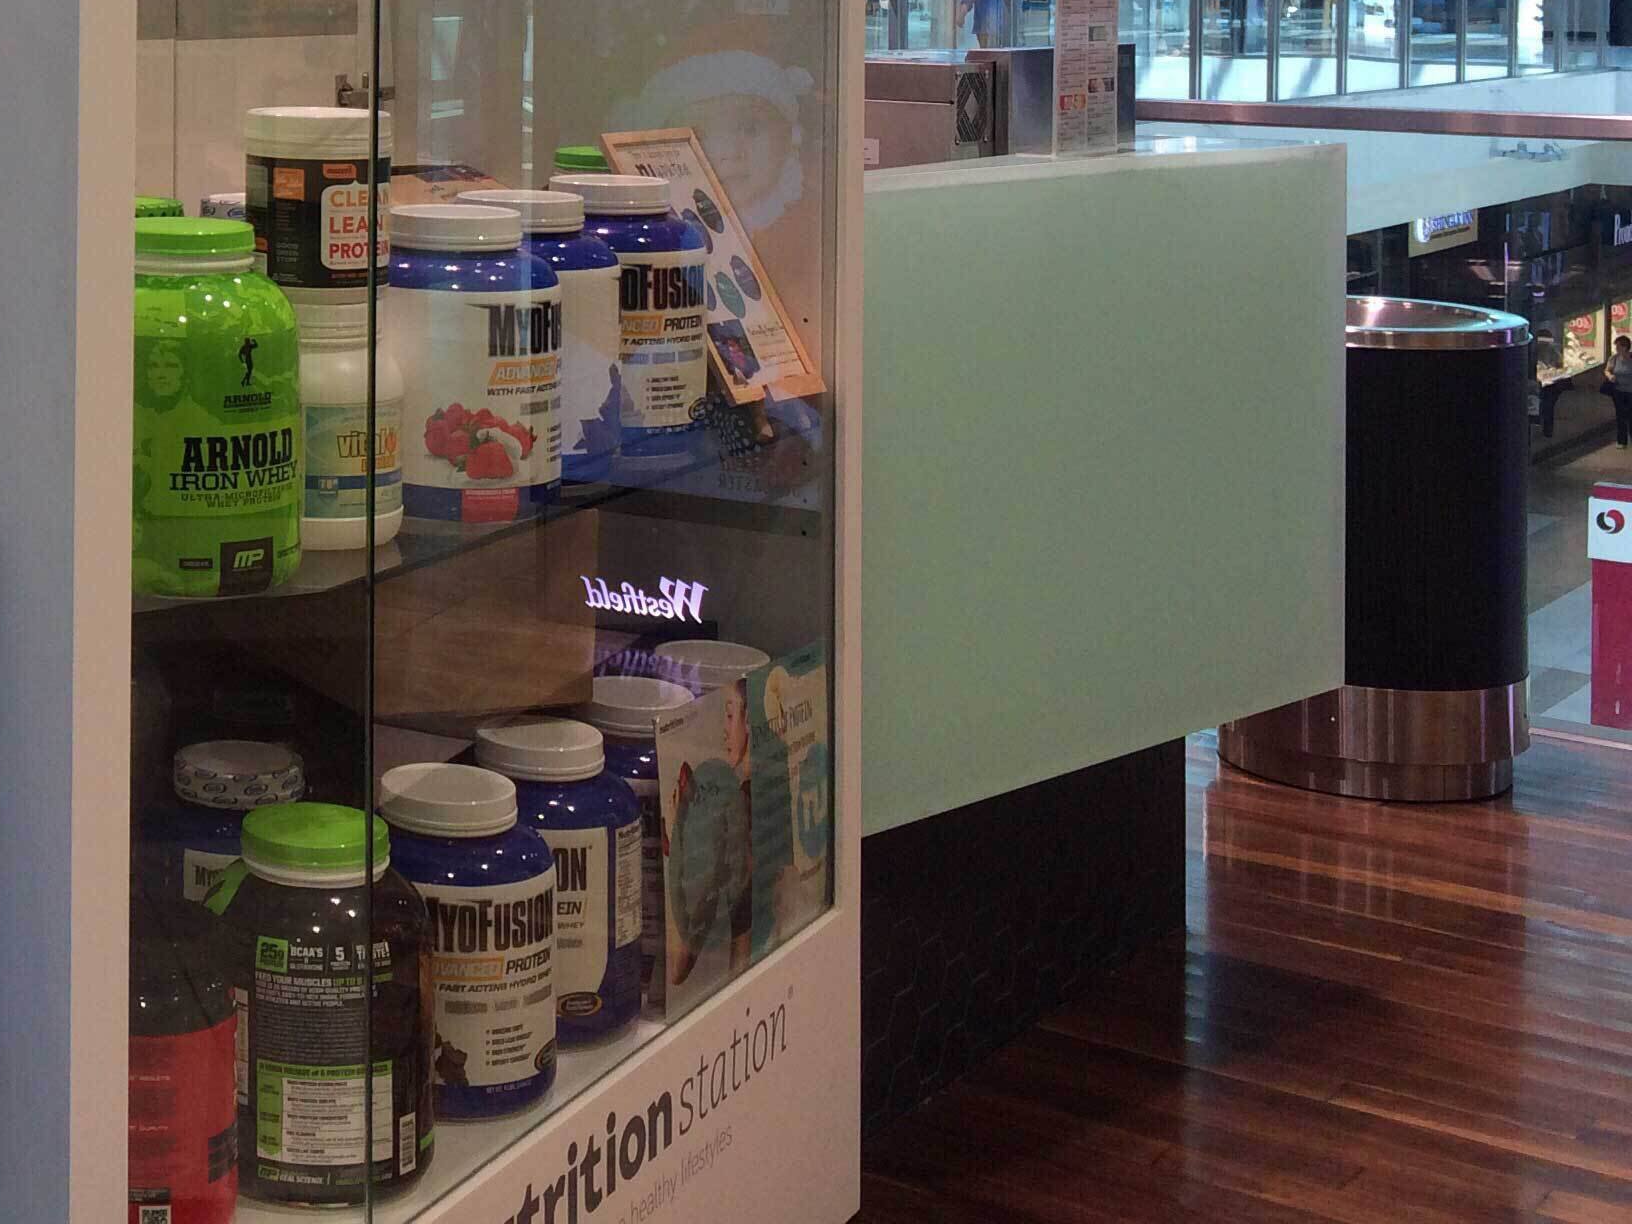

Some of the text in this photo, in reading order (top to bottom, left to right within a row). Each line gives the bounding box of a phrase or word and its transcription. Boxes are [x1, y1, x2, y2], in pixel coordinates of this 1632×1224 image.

[329, 216, 383, 234] LEAN
[329, 240, 389, 259] PROTEIN
[663, 315, 702, 332] PROTEIN
[224, 392, 272, 406] ARNOLD
[487, 387, 514, 396] WITH
[515, 386, 535, 396] FAST
[181, 427, 293, 473] ARNOLD
[169, 460, 298, 492] IRON WHEY
[290, 945, 323, 958] BCAA'S
[334, 946, 345, 961] 5
[506, 947, 551, 975] PROTEIN
[272, 974, 292, 985] YOUR
[293, 977, 332, 987] MUSCLES
[439, 983, 466, 993] FAST
[468, 982, 507, 993] ACTING
[509, 975, 537, 991] HYDRO
[505, 1091, 673, 1224] trition
[679, 1003, 787, 1136] station
[630, 1125, 733, 1222] healthy lifestyles
